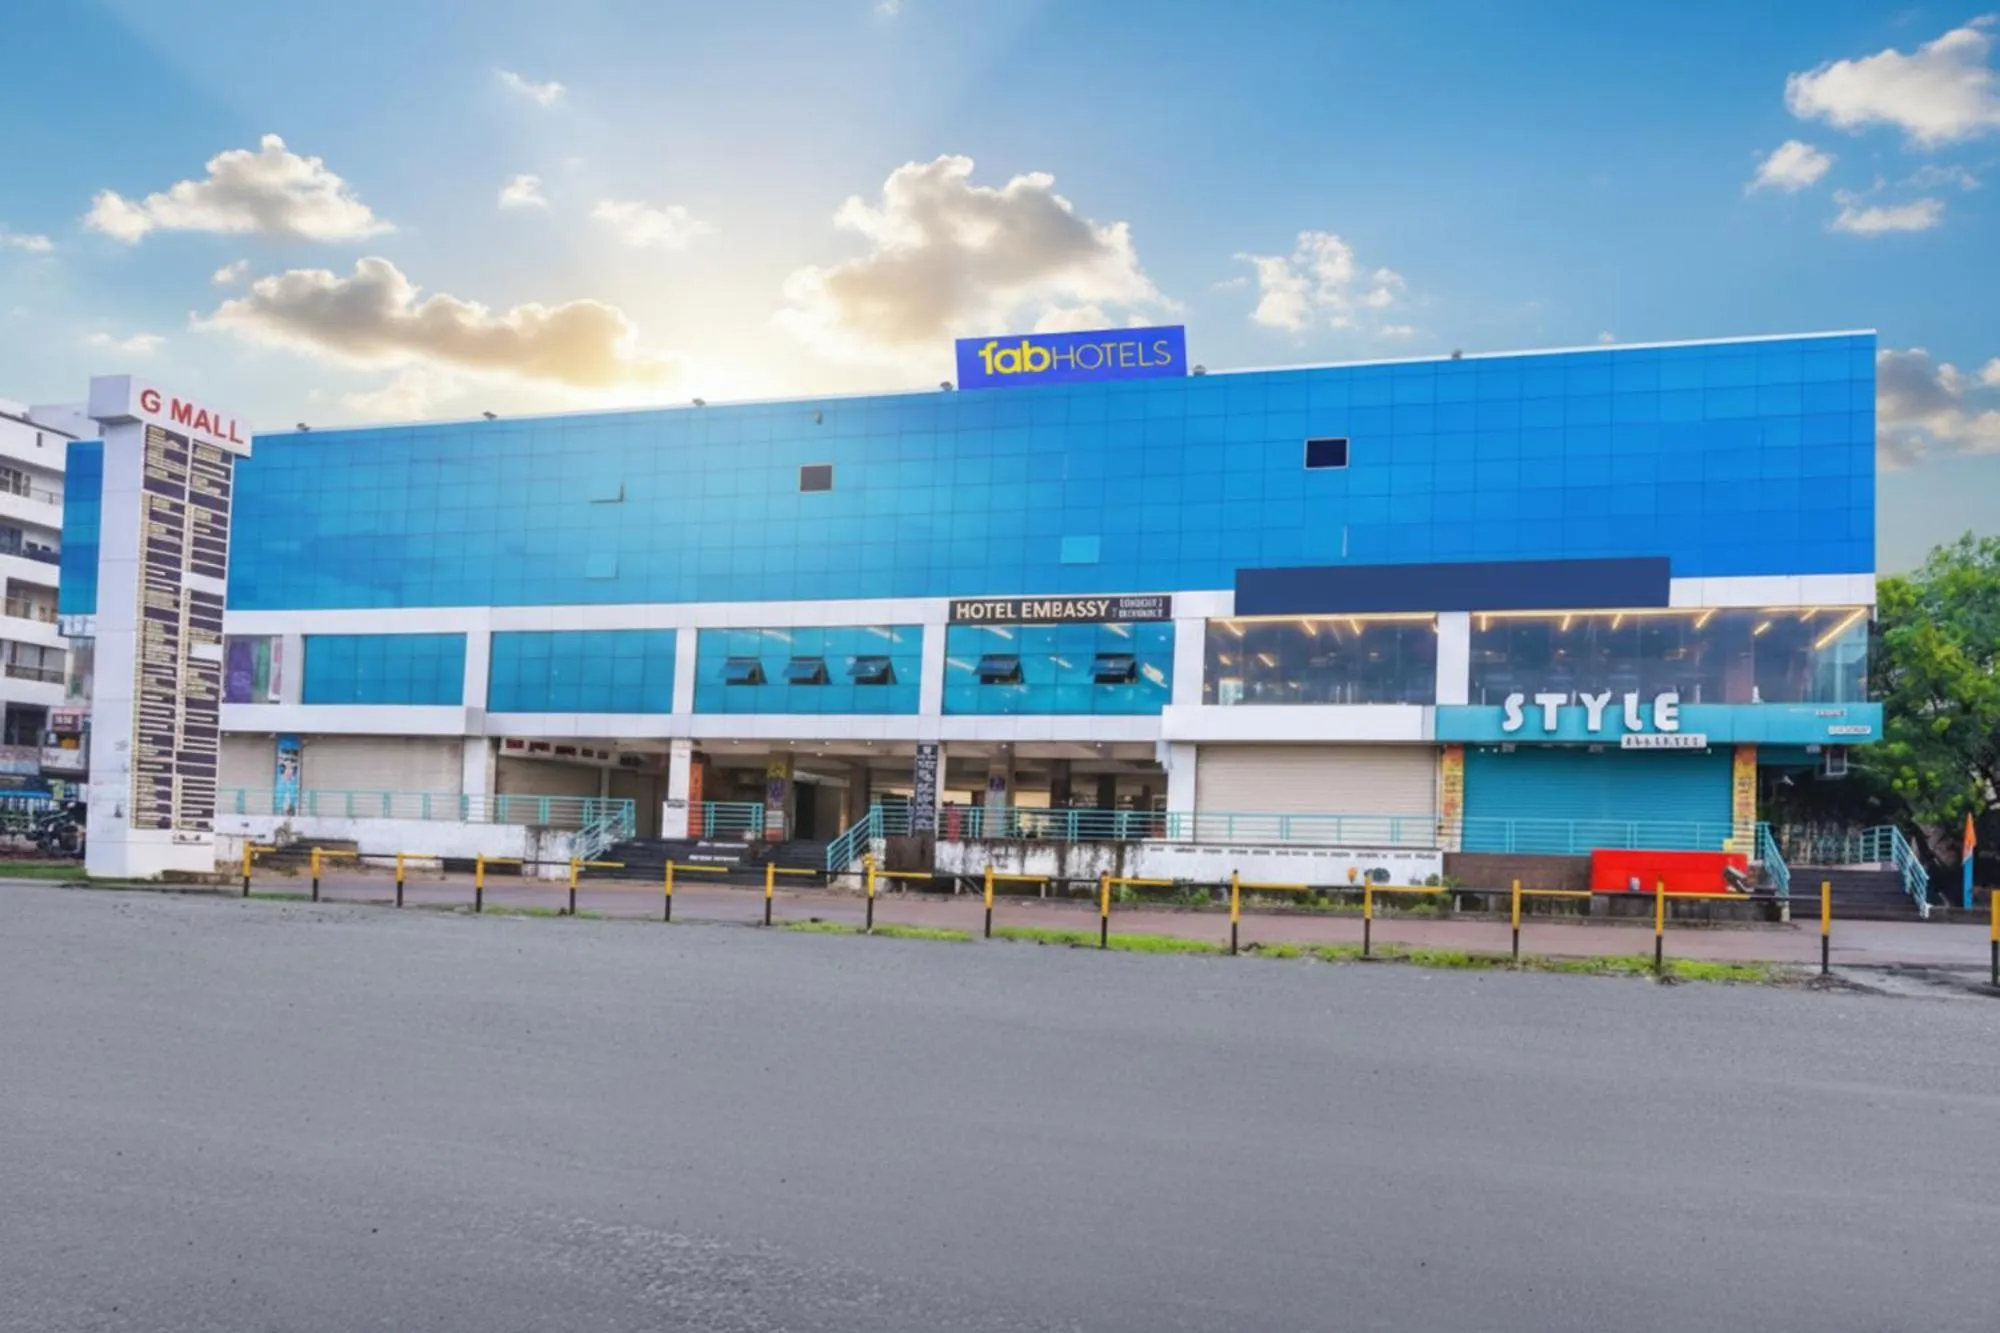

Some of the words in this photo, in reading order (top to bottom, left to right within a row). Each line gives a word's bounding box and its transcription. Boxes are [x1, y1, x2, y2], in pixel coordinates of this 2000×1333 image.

[978, 340, 1172, 375] fabHOTELS
[140, 389, 161, 414] G
[170, 398, 244, 444] MALL
[956, 602, 1017, 619] HOTEL
[1021, 600, 1110, 618] EMBASSY
[1502, 692, 1680, 732] STYLE
